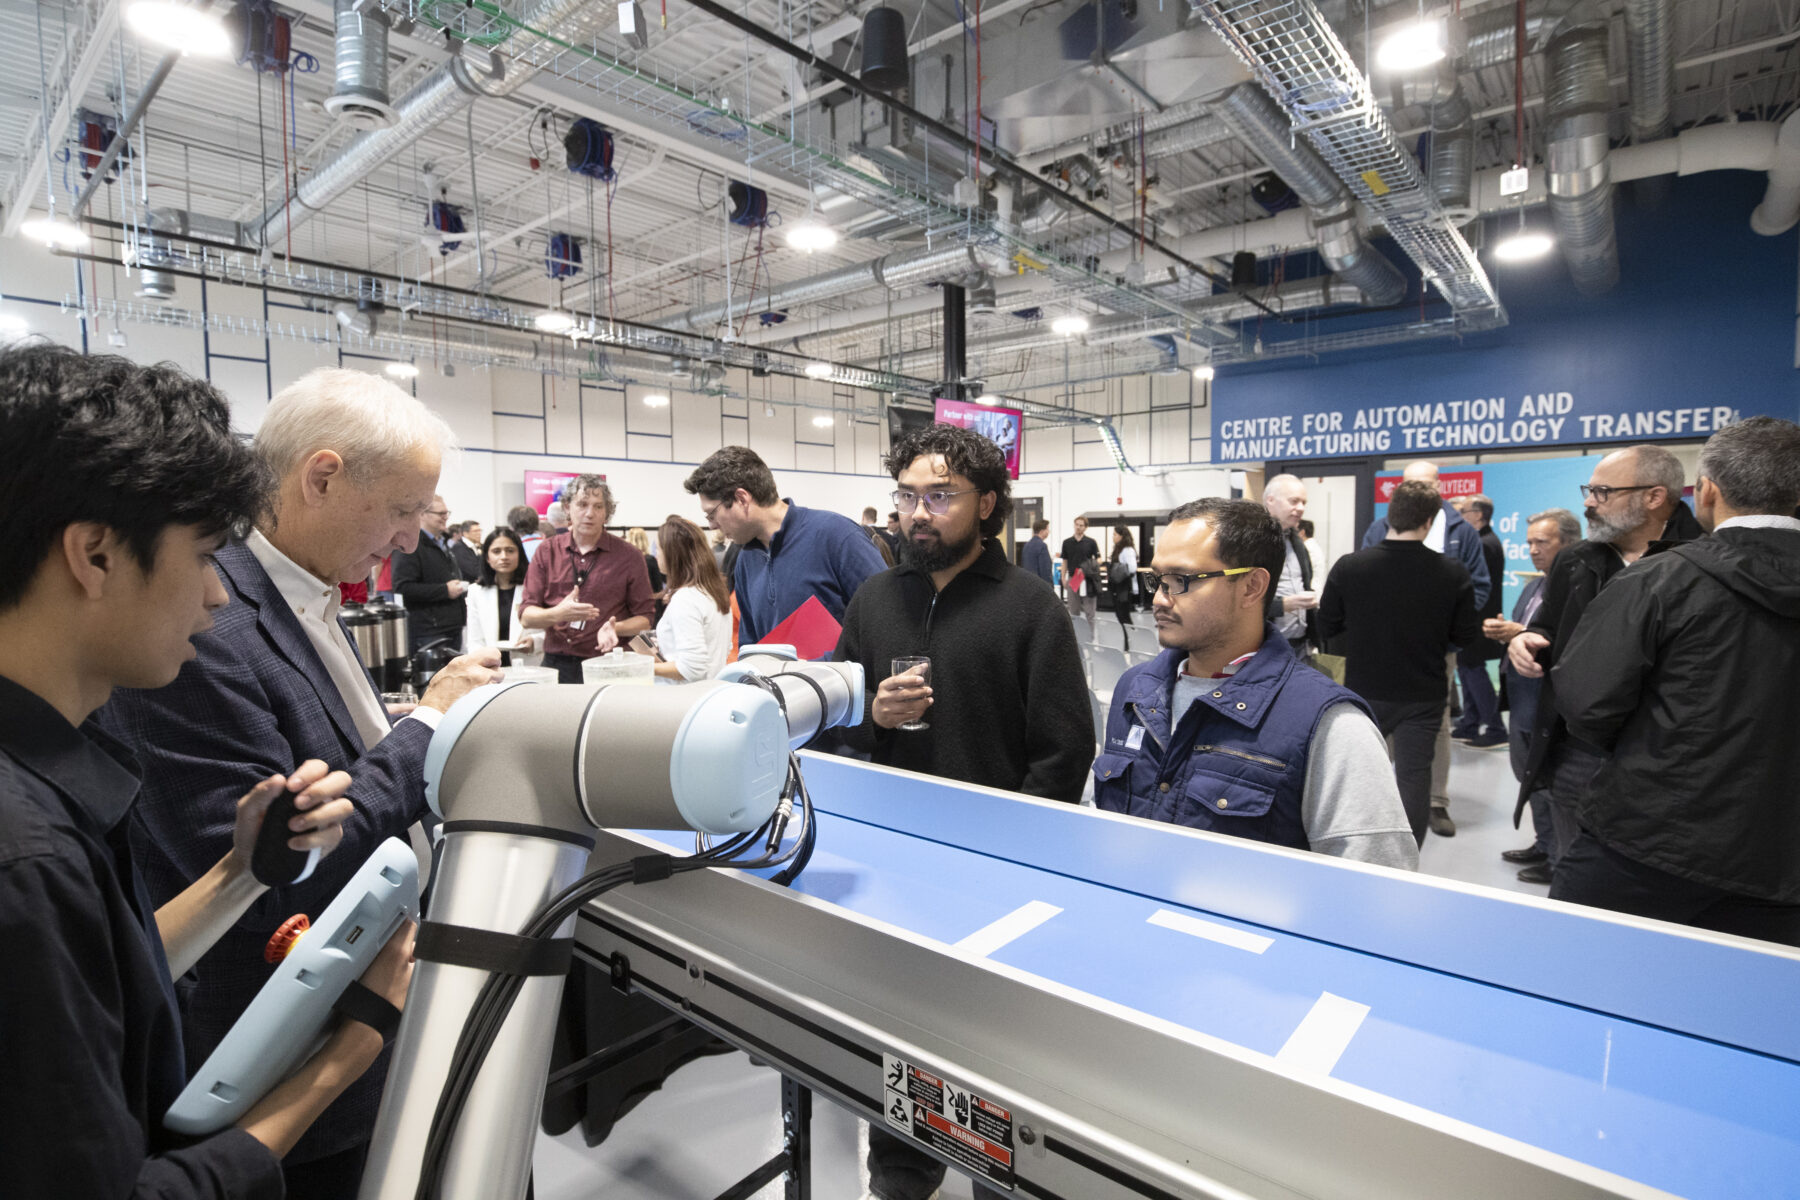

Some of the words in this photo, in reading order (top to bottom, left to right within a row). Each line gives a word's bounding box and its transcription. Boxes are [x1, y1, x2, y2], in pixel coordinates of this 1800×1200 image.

[1220, 416, 1293, 440] CENTRE
[1302, 411, 1343, 434] FOR
[1353, 397, 1505, 430] AUTOMATION
[1518, 391, 1574, 418] AND
[1220, 430, 1391, 461] MANUFACTURING
[1402, 417, 1565, 449] TECHNOLOGY
[1579, 406, 1732, 438] TRANSFER
[1499, 512, 1520, 533] of
[919, 1072, 938, 1086] DANGER
[984, 1103, 1005, 1119] DANGER
[950, 1124, 985, 1151] WARNING
